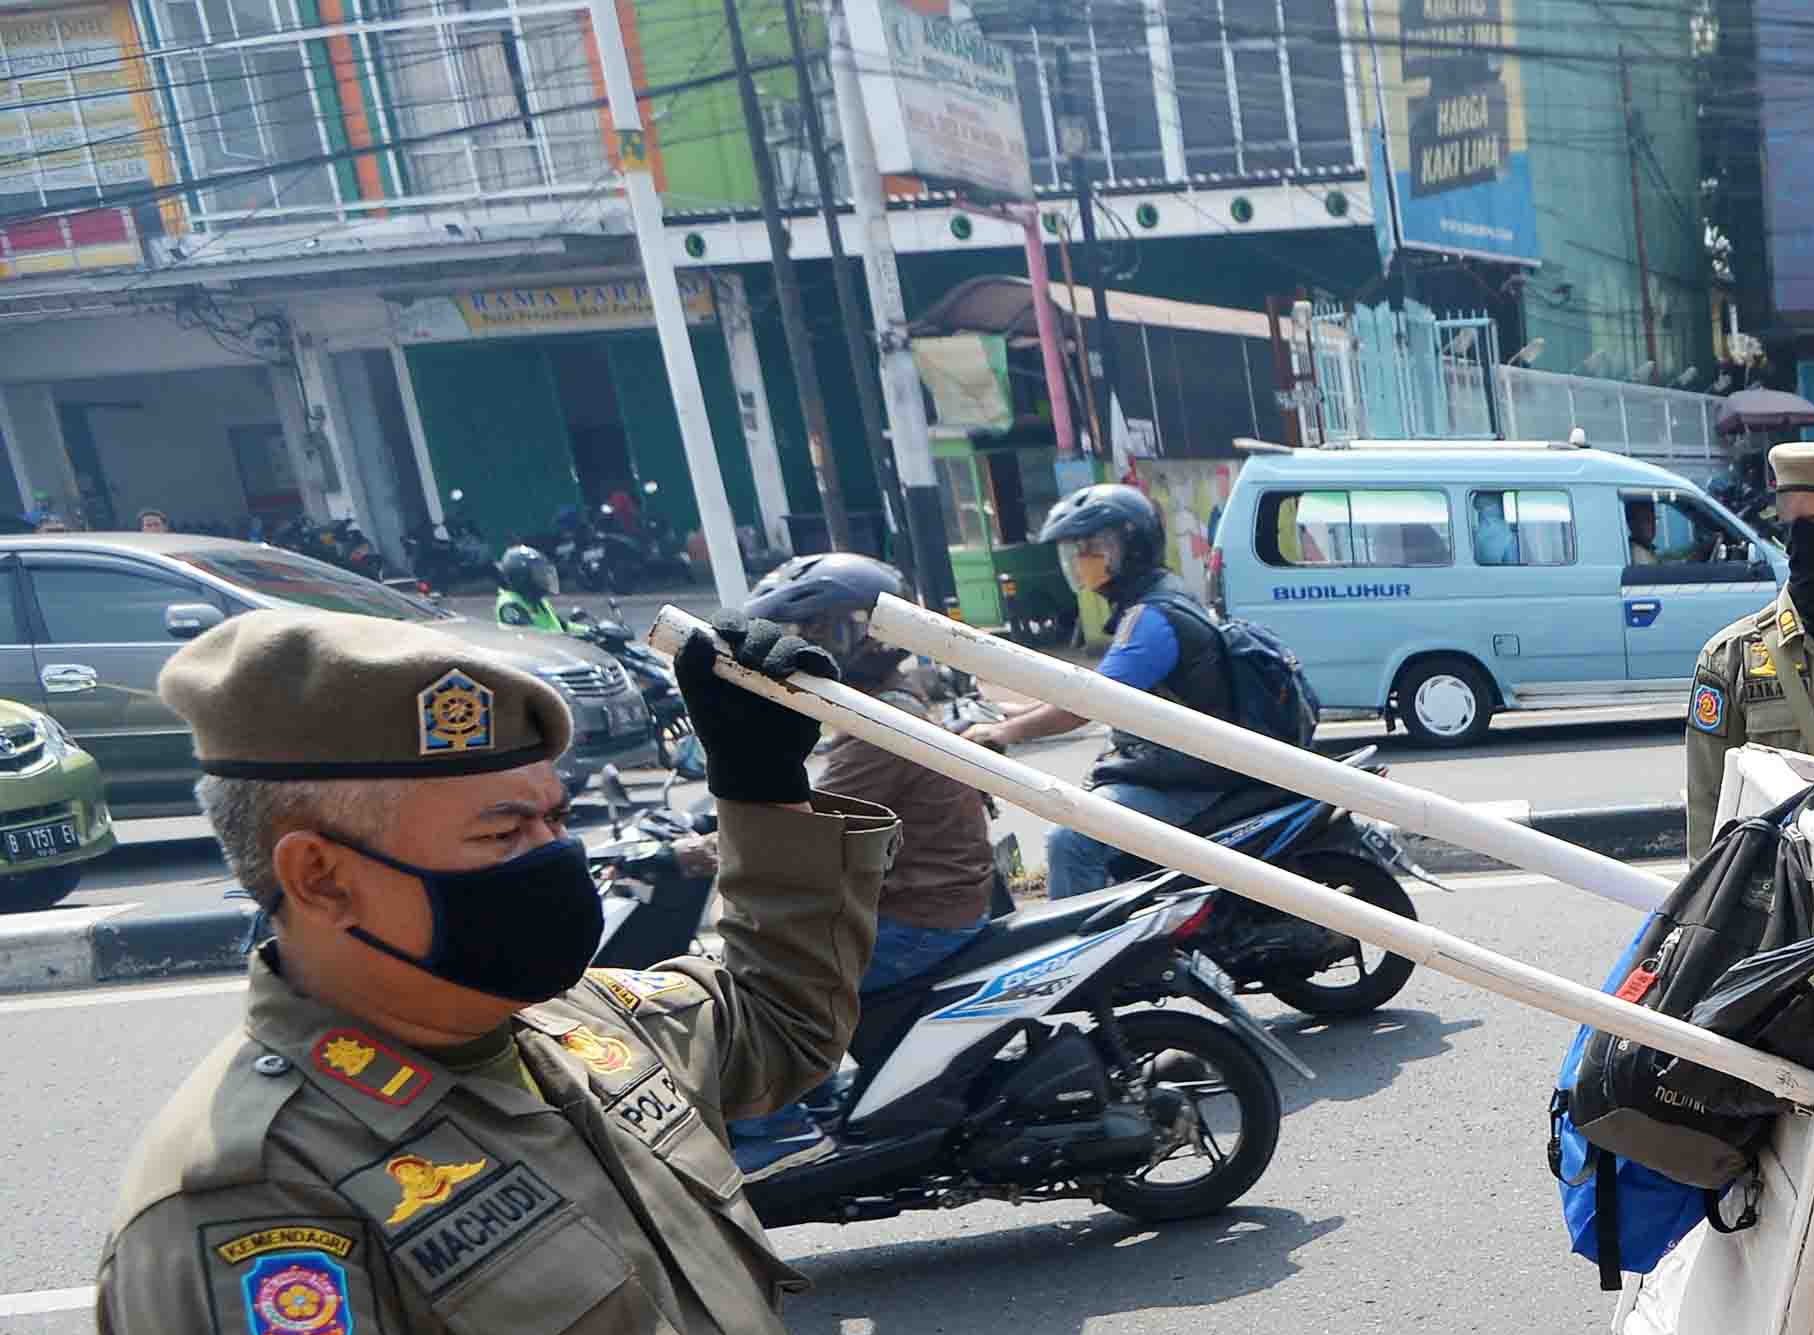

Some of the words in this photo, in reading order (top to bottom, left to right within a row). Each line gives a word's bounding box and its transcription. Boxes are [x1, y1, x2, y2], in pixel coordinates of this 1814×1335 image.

[1438, 94, 1489, 136] HARGA
[1422, 141, 1460, 184] KAKI
[1463, 135, 1500, 175] LIMA
[1272, 583, 1411, 601] BUDILUHUR
[621, 1089, 677, 1133] POL
[226, 1229, 347, 1257] KEMENDAGRI
[409, 1175, 547, 1279] MACHUDI
